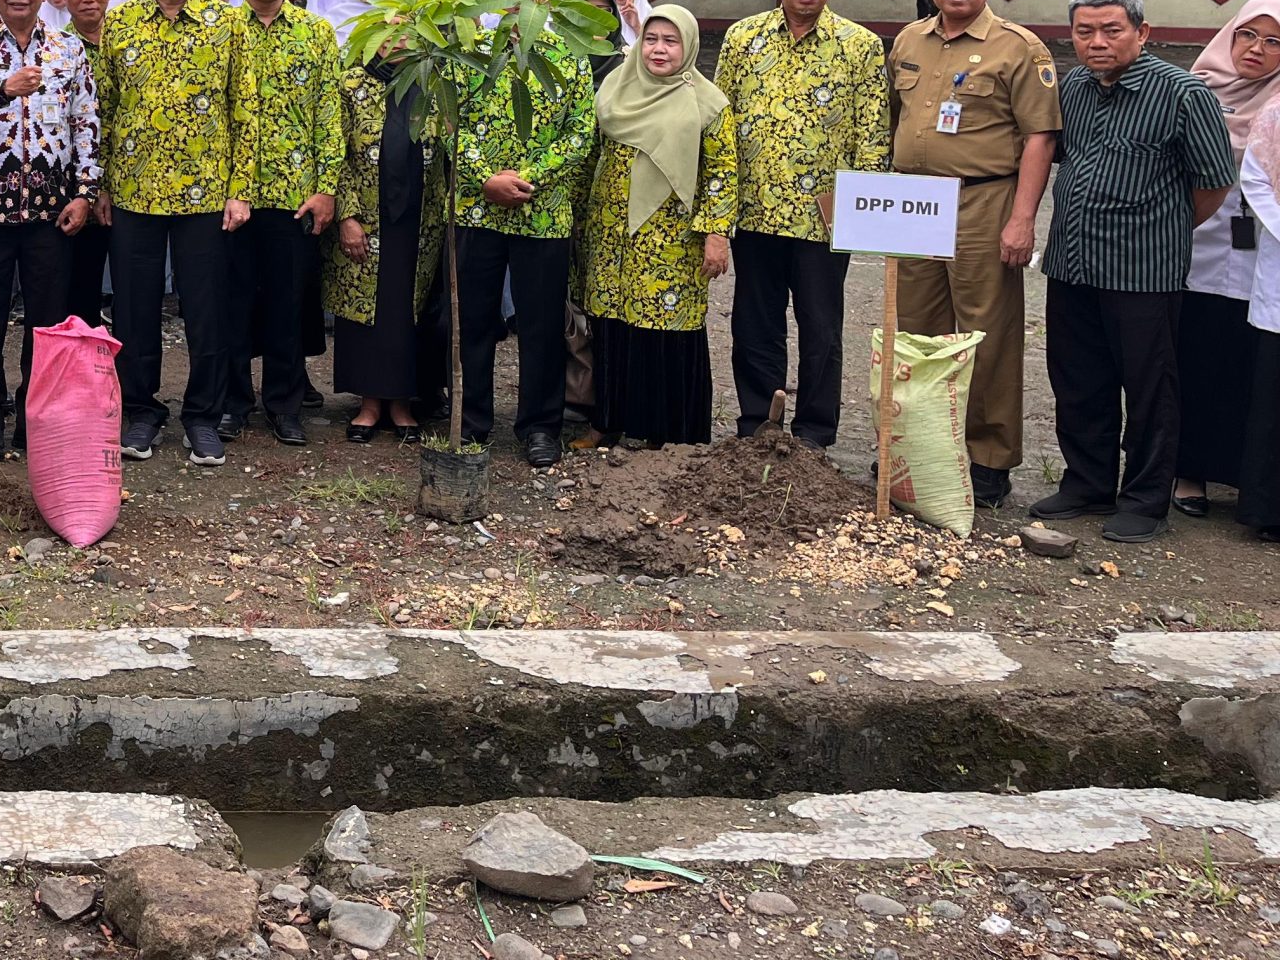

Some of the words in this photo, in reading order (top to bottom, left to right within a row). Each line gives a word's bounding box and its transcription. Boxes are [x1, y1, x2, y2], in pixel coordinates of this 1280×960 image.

[855, 197, 894, 212] DPP
[902, 200, 939, 216] DMI
[947, 370, 960, 407] CASTING
[950, 407, 960, 445] GYPSUM
